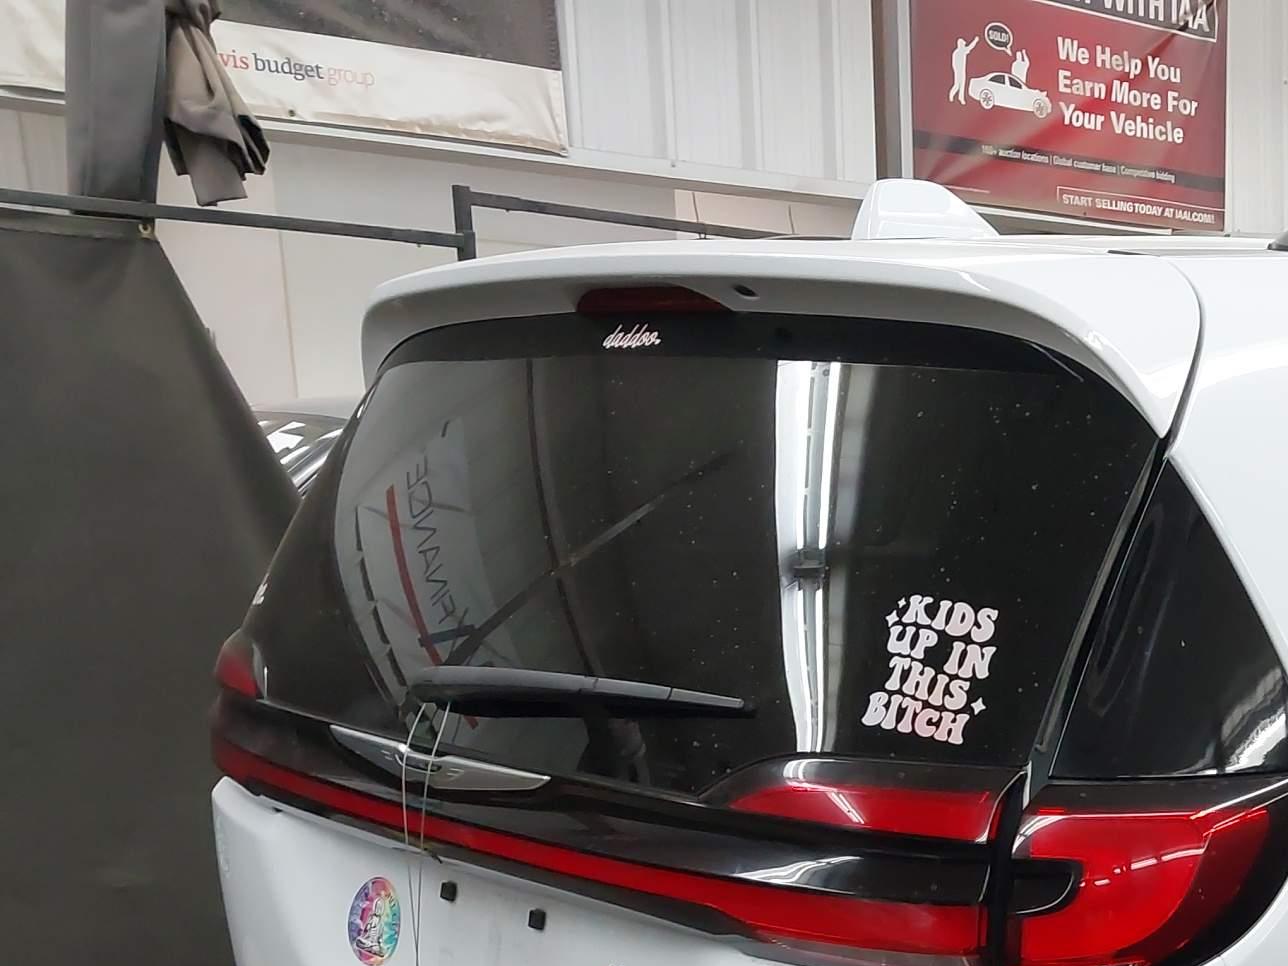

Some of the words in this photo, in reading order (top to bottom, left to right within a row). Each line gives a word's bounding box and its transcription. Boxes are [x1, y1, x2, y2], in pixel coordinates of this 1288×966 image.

[989, 30, 1009, 43] SOLD!
[1057, 36, 1090, 66] We
[1096, 45, 1142, 79] Help
[1147, 56, 1181, 83] You
[218, 49, 249, 70] vis
[252, 53, 325, 81] budget
[327, 66, 375, 90] group
[1058, 70, 1106, 100] Earn
[1111, 80, 1161, 110] More
[1167, 91, 1199, 117] For
[1059, 101, 1105, 132] Your
[1111, 112, 1184, 144] Vehicle
[1062, 193, 1093, 208] START
[1095, 198, 1134, 213] SELLING
[1134, 203, 1163, 217] TODAY
[1163, 208, 1175, 218] AT
[901, 594, 998, 643] KIDS
[886, 625, 938, 660] UP
[943, 641, 997, 680] IN
[884, 656, 971, 711] THIS
[861, 691, 970, 745] BITCH
